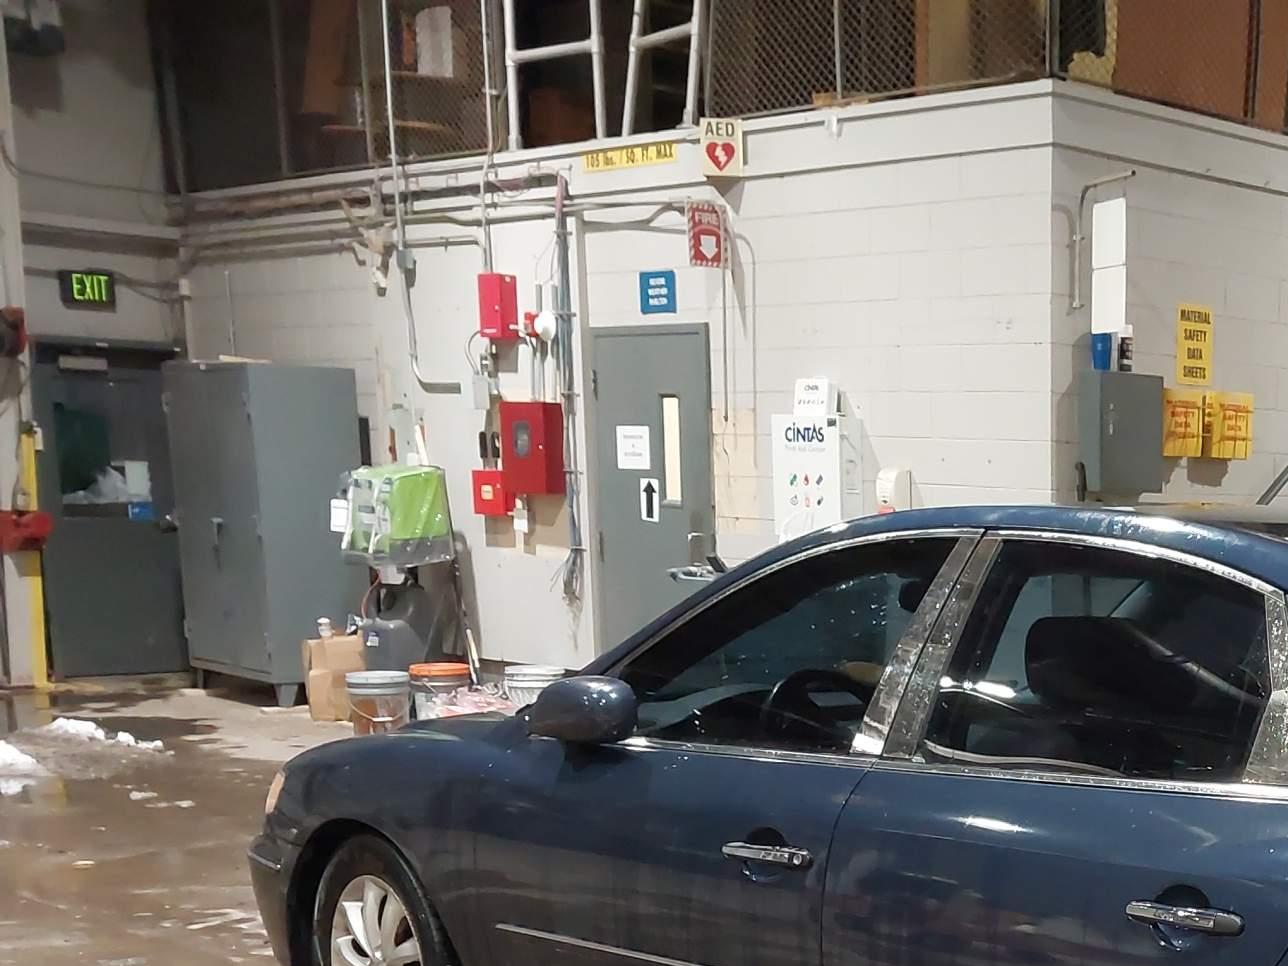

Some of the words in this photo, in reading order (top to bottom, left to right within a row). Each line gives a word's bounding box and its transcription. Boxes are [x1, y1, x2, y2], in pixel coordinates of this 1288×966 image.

[705, 121, 735, 137] AED
[586, 154, 600, 169] 105
[603, 153, 617, 167] lbs.
[626, 149, 639, 165] SQ.
[642, 147, 653, 162] FT.
[656, 144, 674, 159] MAX
[694, 211, 719, 225] FIRE
[72, 273, 109, 302] EXIT
[1180, 309, 1211, 325] MATERIAL
[1183, 328, 1207, 343] SAFETY
[1187, 347, 1203, 361] DATA
[1183, 365, 1206, 380] SHEETS
